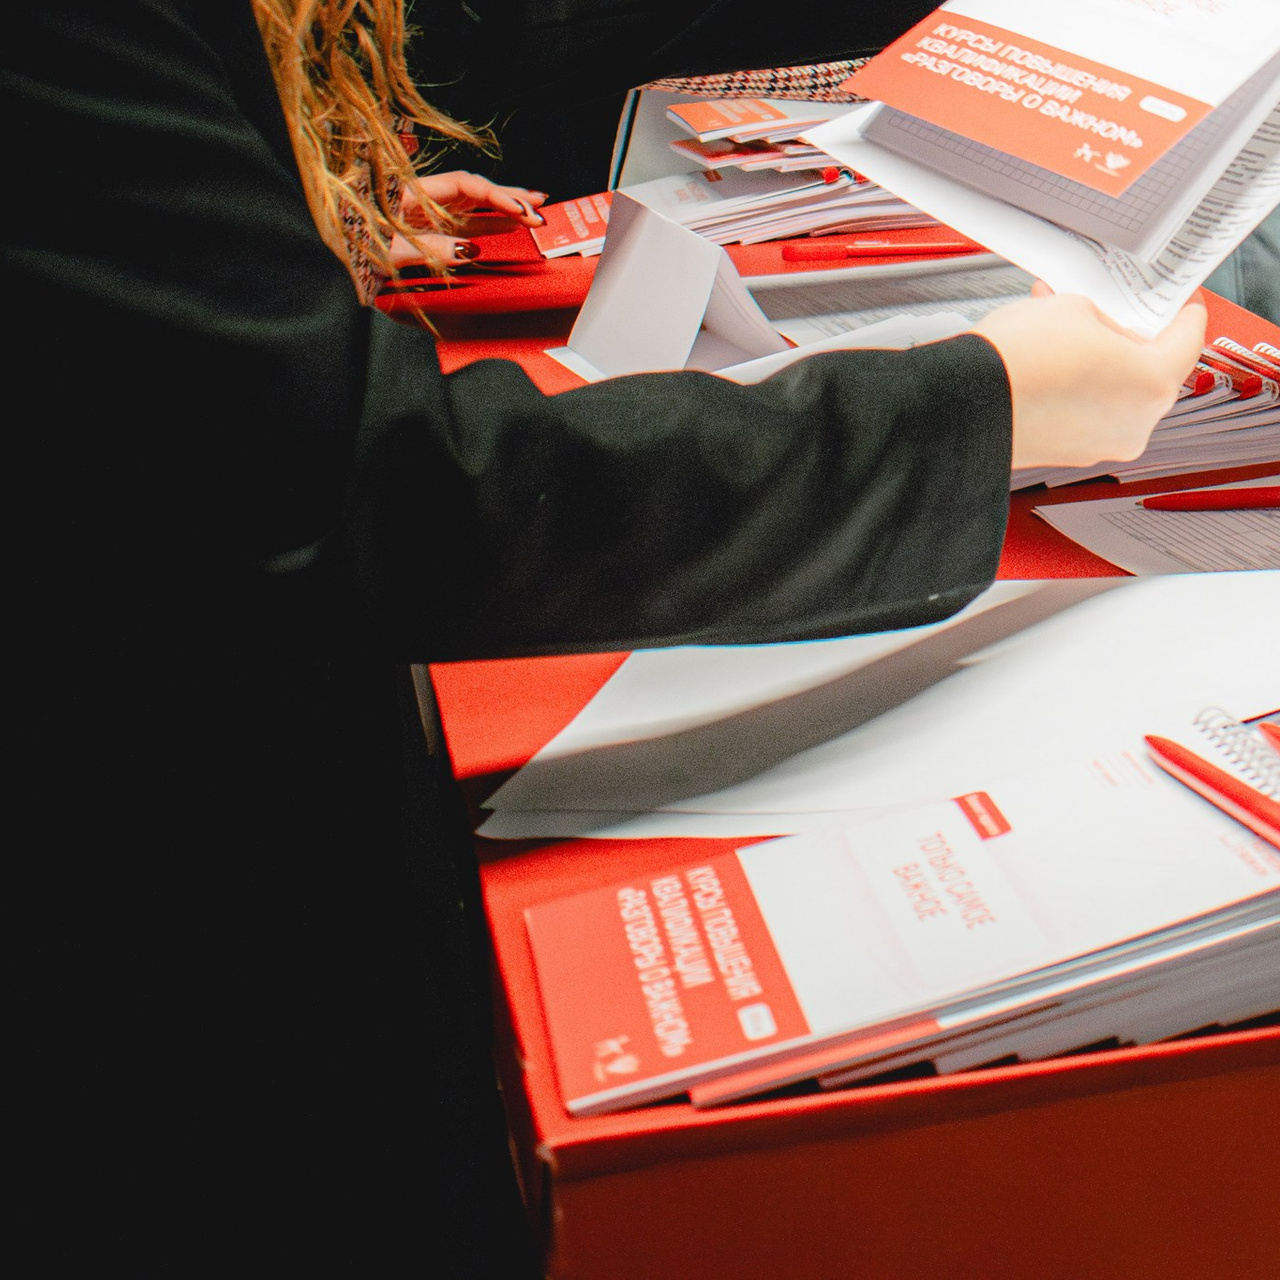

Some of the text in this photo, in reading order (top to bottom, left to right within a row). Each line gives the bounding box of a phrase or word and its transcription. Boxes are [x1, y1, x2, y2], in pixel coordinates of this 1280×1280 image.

[916, 36, 1083, 104] КВАЛИФИКАЦИИ
[932, 23, 1132, 102] КУРСЫ ПОВЫШЕНИЯ
[900, 52, 1022, 104] «РАЗГОВОРЫ
[1021, 93, 1043, 109] О
[1038, 101, 1144, 149] ВАЖНОМ»
[686, 865, 725, 909] КУРСЫ
